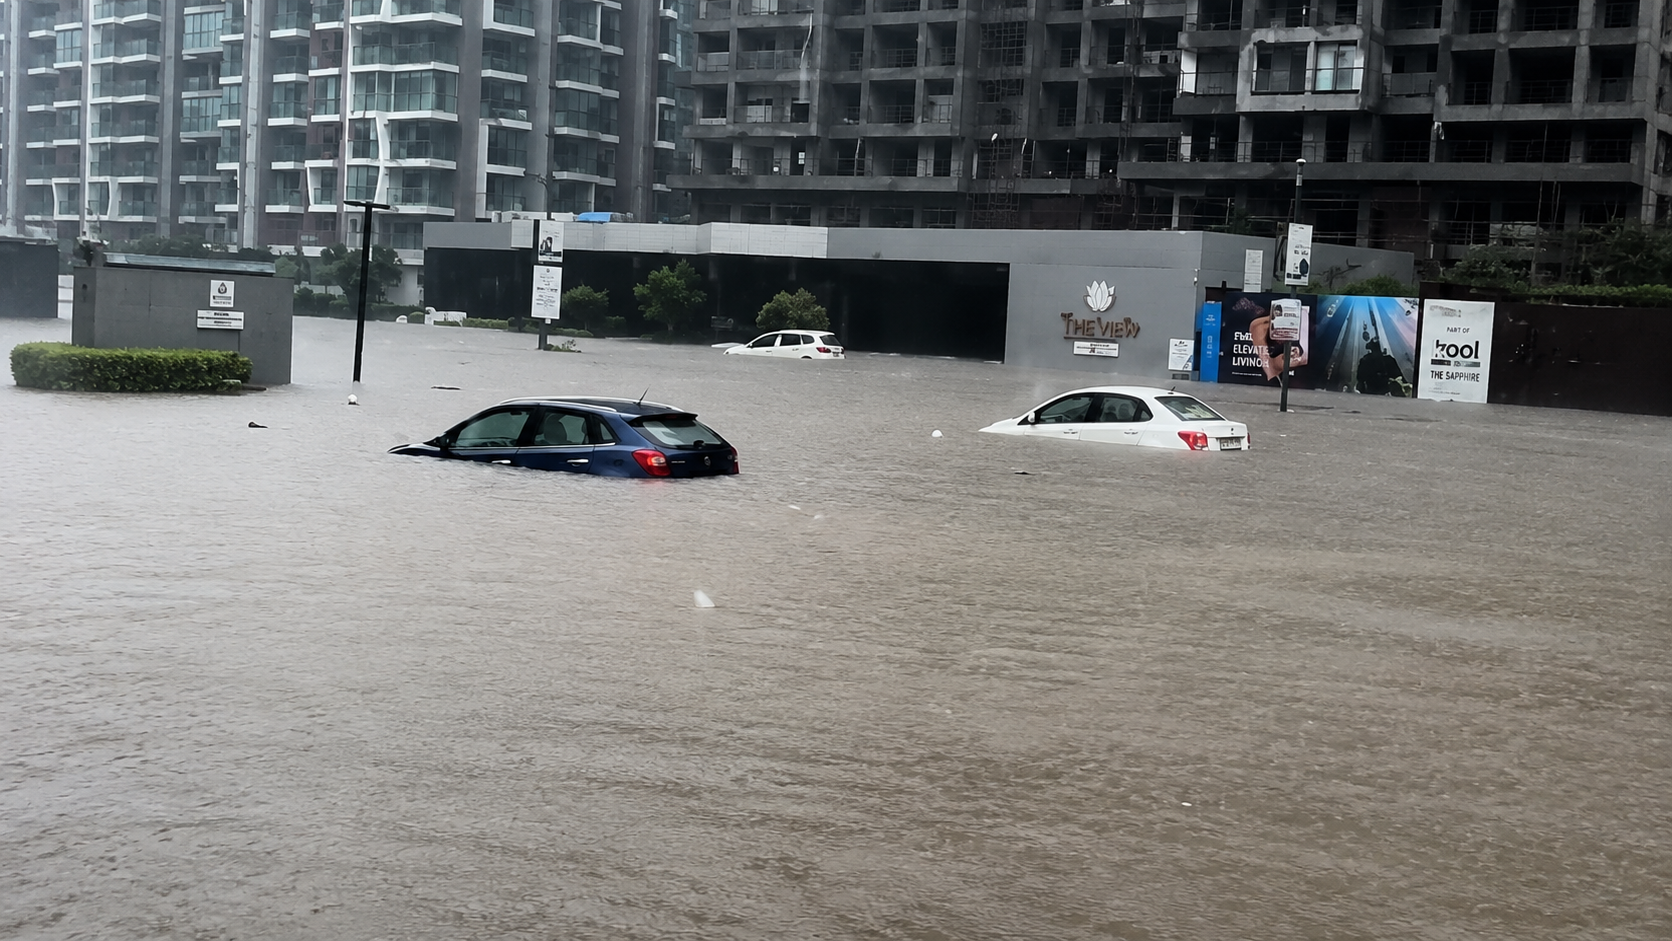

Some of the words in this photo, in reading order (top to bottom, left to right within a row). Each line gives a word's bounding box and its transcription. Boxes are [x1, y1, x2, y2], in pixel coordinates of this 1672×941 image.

[1060, 312, 1096, 337] THE
[1097, 317, 1141, 339] VIEW
[1430, 370, 1444, 380] THE
[1445, 371, 1481, 383] SAPPHIRE
